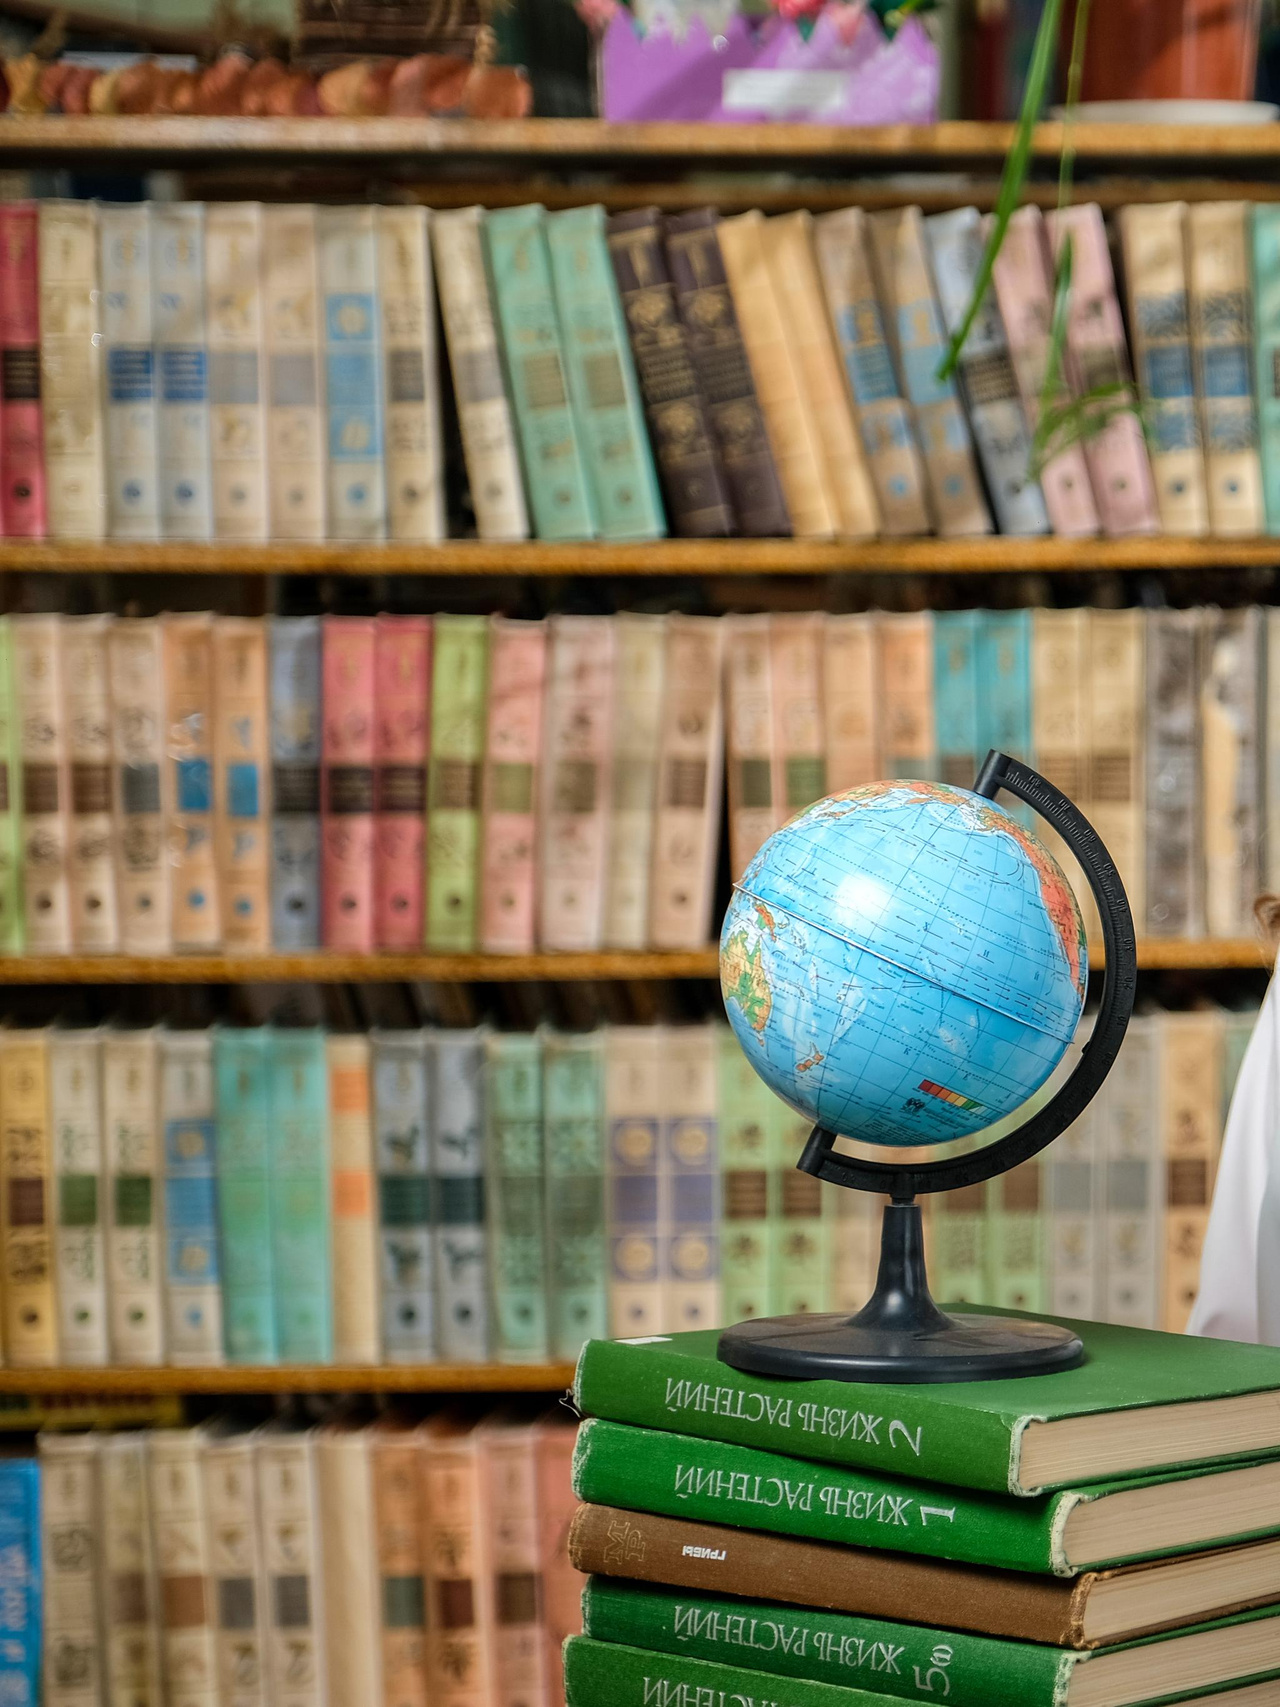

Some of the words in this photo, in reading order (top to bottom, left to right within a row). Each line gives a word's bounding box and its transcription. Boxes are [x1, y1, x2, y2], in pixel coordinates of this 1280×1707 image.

[664, 1377, 791, 1428] РАСТЕНИЙ
[797, 1401, 883, 1445] ЖИЗНЬ
[888, 1419, 922, 1456] 2
[674, 1464, 813, 1512] РАСТЕНИЙ
[819, 1486, 914, 1527] ЖИЗНЬ
[919, 1505, 956, 1527] 1
[682, 1545, 727, 1561] ГРИБЫ
[673, 1605, 809, 1658] РАСТЕНИЙ
[812, 1631, 905, 1675] ЖИЗНЬ
